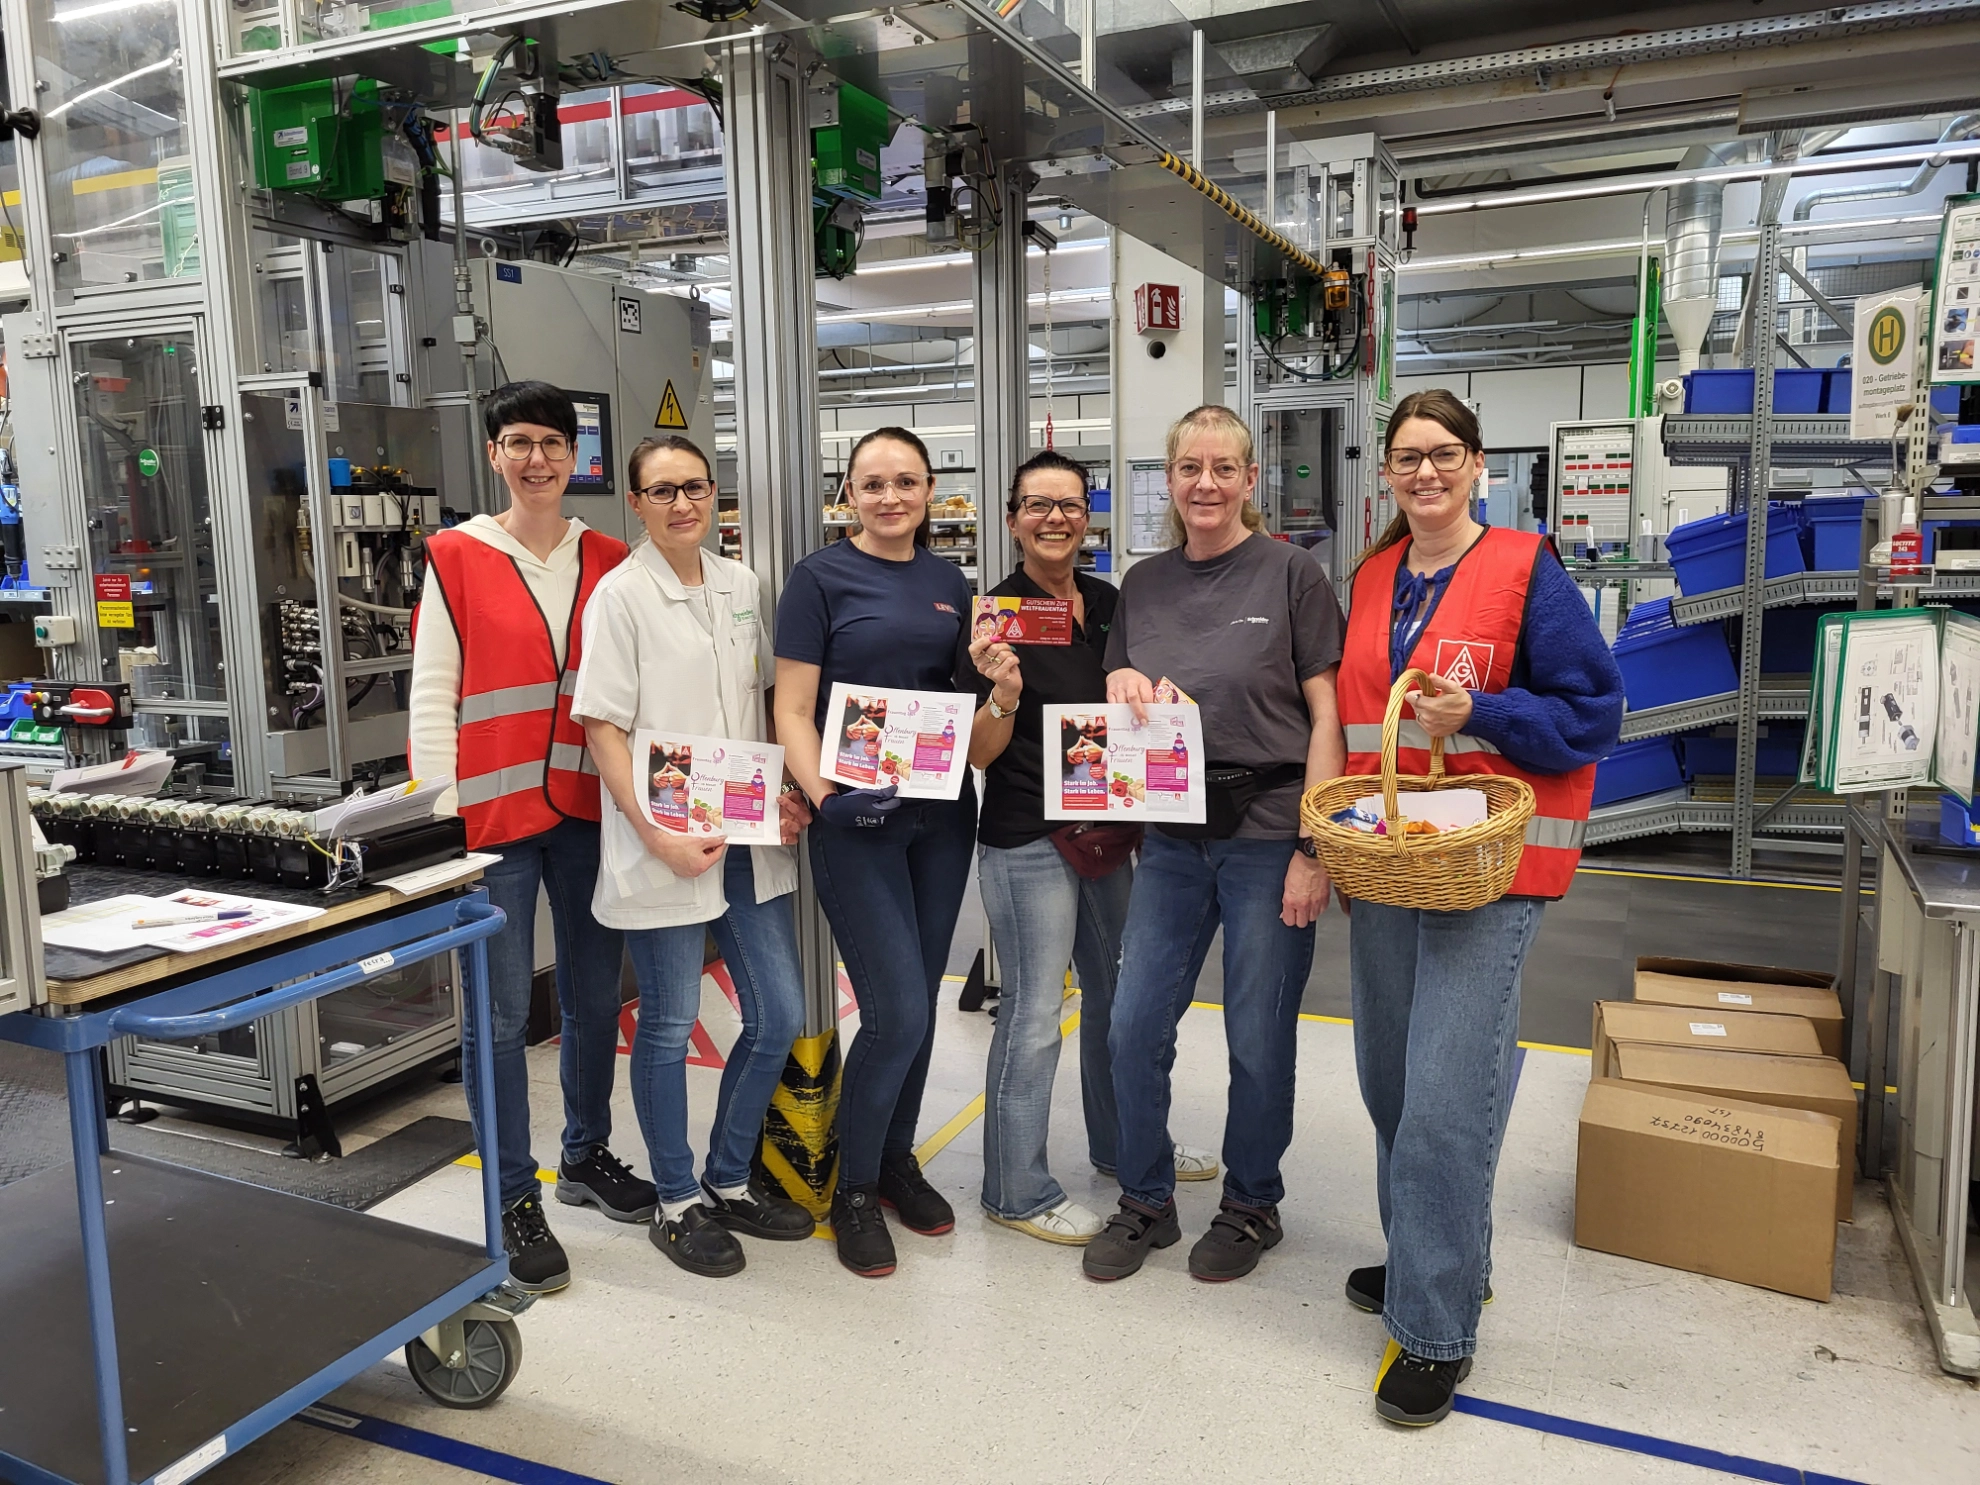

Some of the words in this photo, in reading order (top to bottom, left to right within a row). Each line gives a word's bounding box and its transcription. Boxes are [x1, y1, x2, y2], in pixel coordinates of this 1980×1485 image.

[503, 268, 515, 278] SS1
[1878, 319, 1895, 353] H
[1862, 375, 1873, 384] 020
[1879, 371, 1908, 382] Getriebe-
[1863, 384, 1905, 396] montageplatz
[1021, 605, 1068, 613] WELTFRAUENTAG
